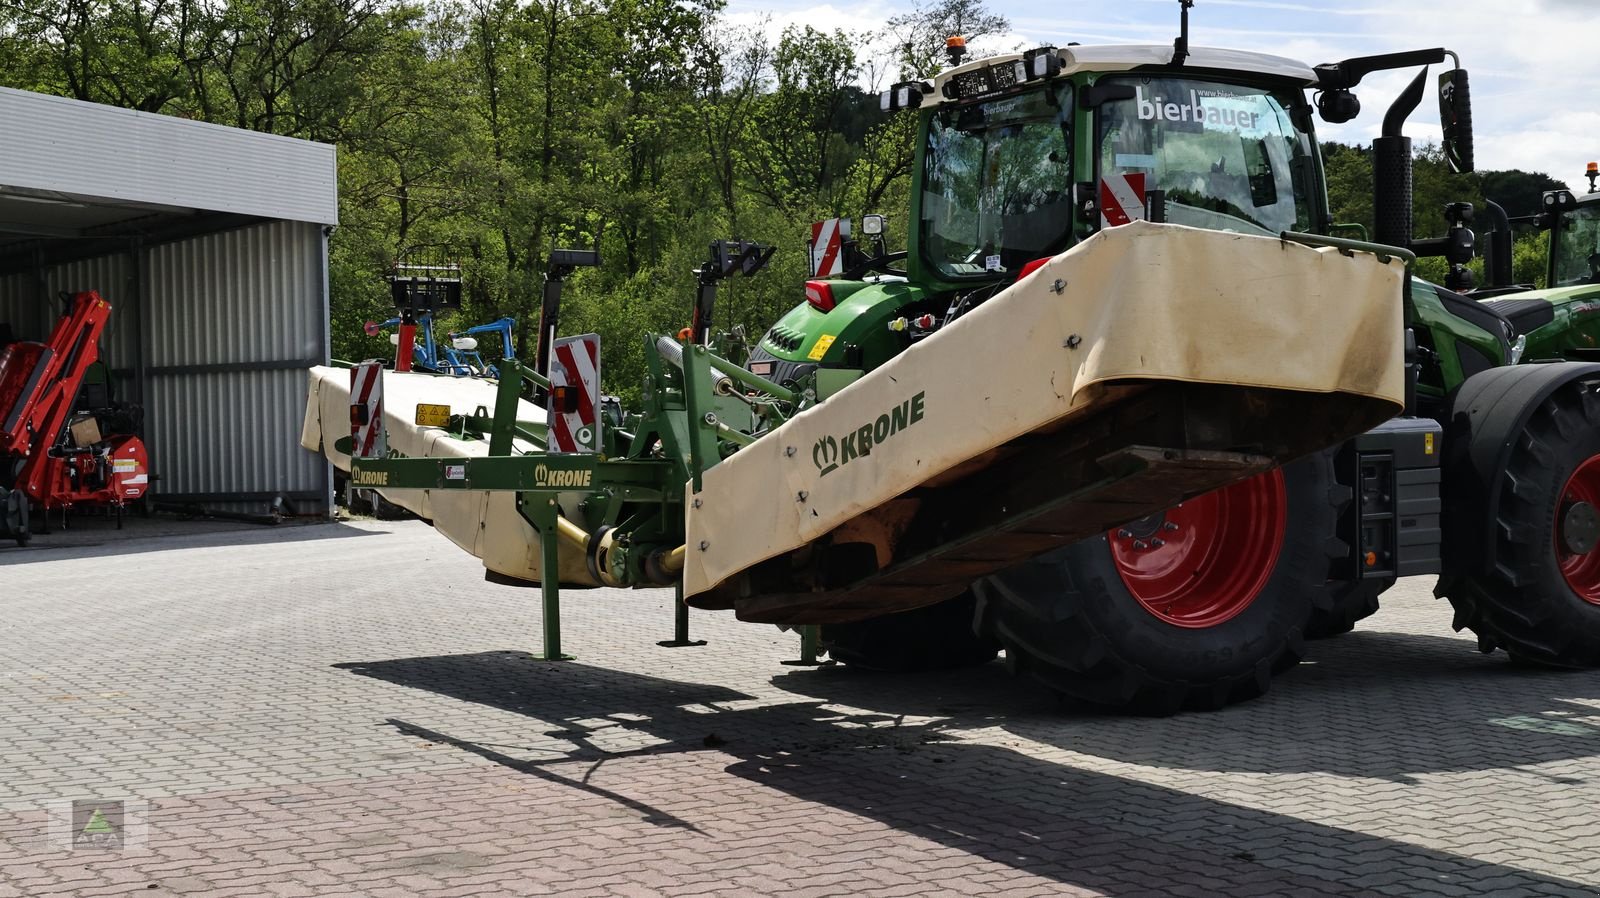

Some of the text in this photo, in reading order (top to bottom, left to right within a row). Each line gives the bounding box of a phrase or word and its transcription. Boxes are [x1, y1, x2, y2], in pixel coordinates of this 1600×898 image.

[1136, 85, 1259, 129] bierbauer
[841, 390, 925, 465] KRONE
[360, 471, 388, 486] KRONE
[547, 469, 593, 487] KRONE
